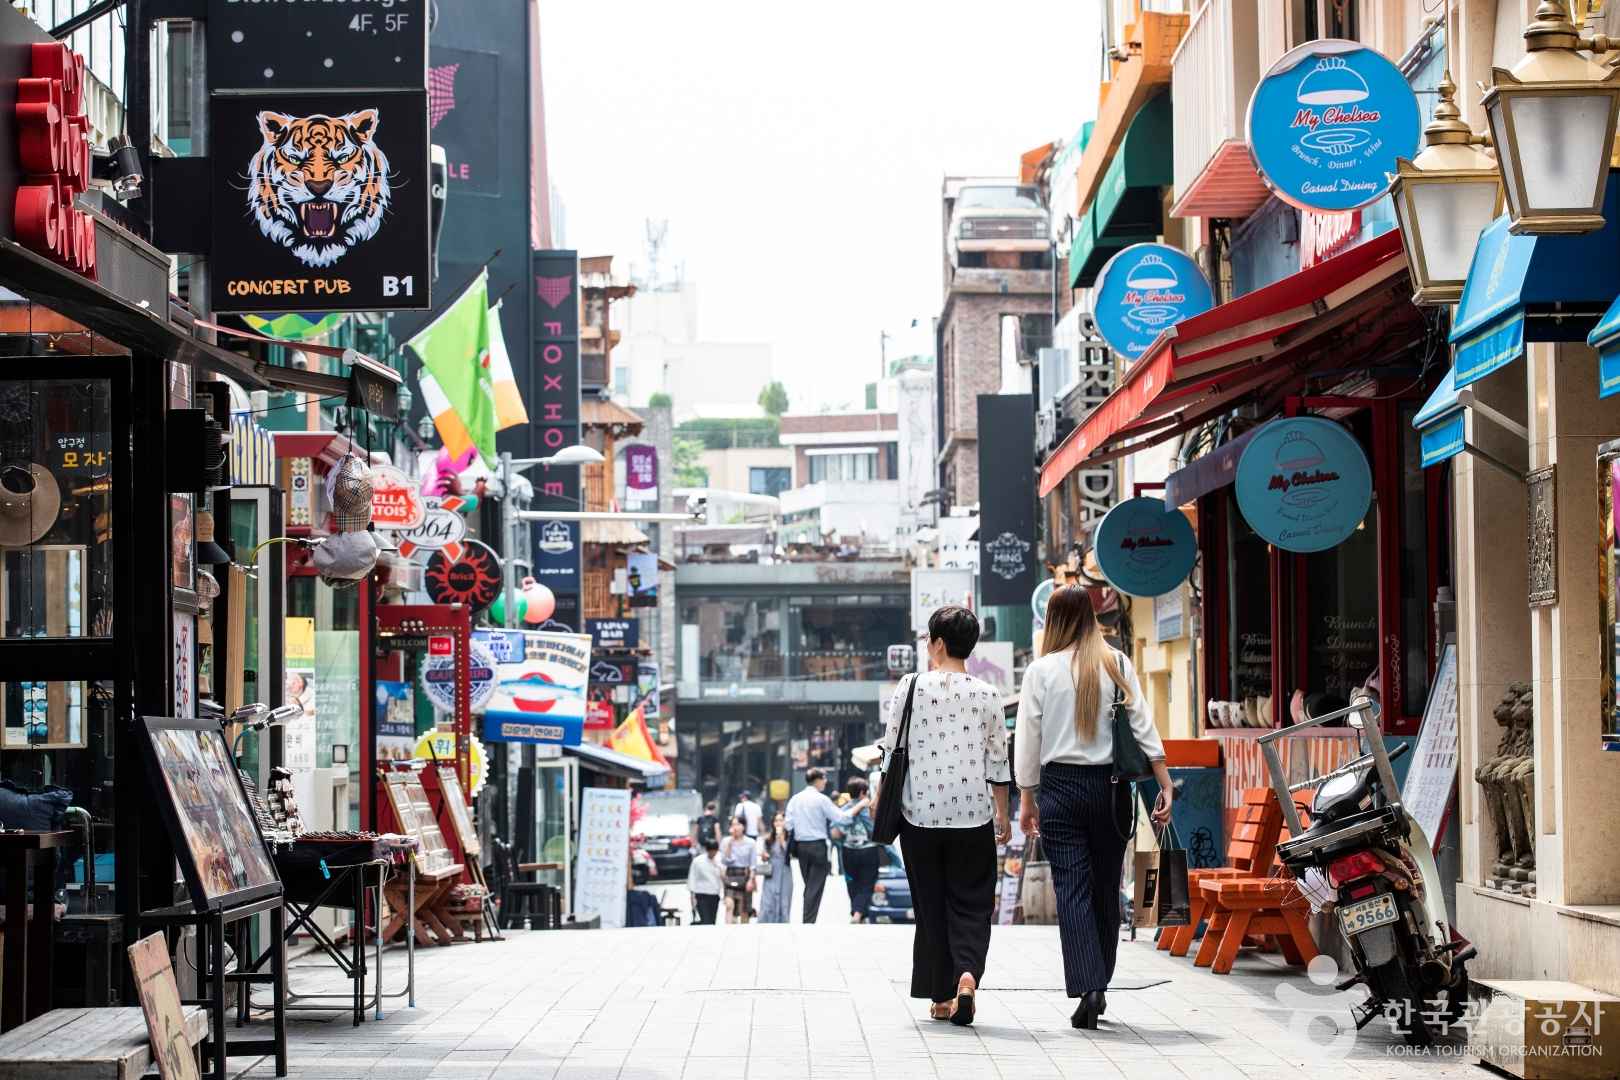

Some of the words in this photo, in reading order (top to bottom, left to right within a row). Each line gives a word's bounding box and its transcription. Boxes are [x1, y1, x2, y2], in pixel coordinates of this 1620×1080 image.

[349, 14, 377, 35] 4F,
[385, 14, 409, 32] 5F
[1290, 107, 1319, 131] My
[1323, 104, 1381, 125] Chelsea
[1301, 180, 1339, 195] Casual
[1341, 176, 1378, 194] Dining
[227, 279, 309, 296] CONCERT
[313, 278, 352, 295] PUB
[382, 275, 413, 297] B1
[1120, 290, 1143, 307] My
[543, 321, 564, 496] FOXHOE
[57, 436, 85, 449] 압구정
[62, 450, 112, 468] 모자
[1267, 475, 1289, 492] My
[373, 494, 406, 505] ELLA
[1121, 537, 1137, 551] My
[994, 553, 1022, 564] MING
[391, 638, 427, 649] WELCOM
[1356, 904, 1395, 928] 9566
